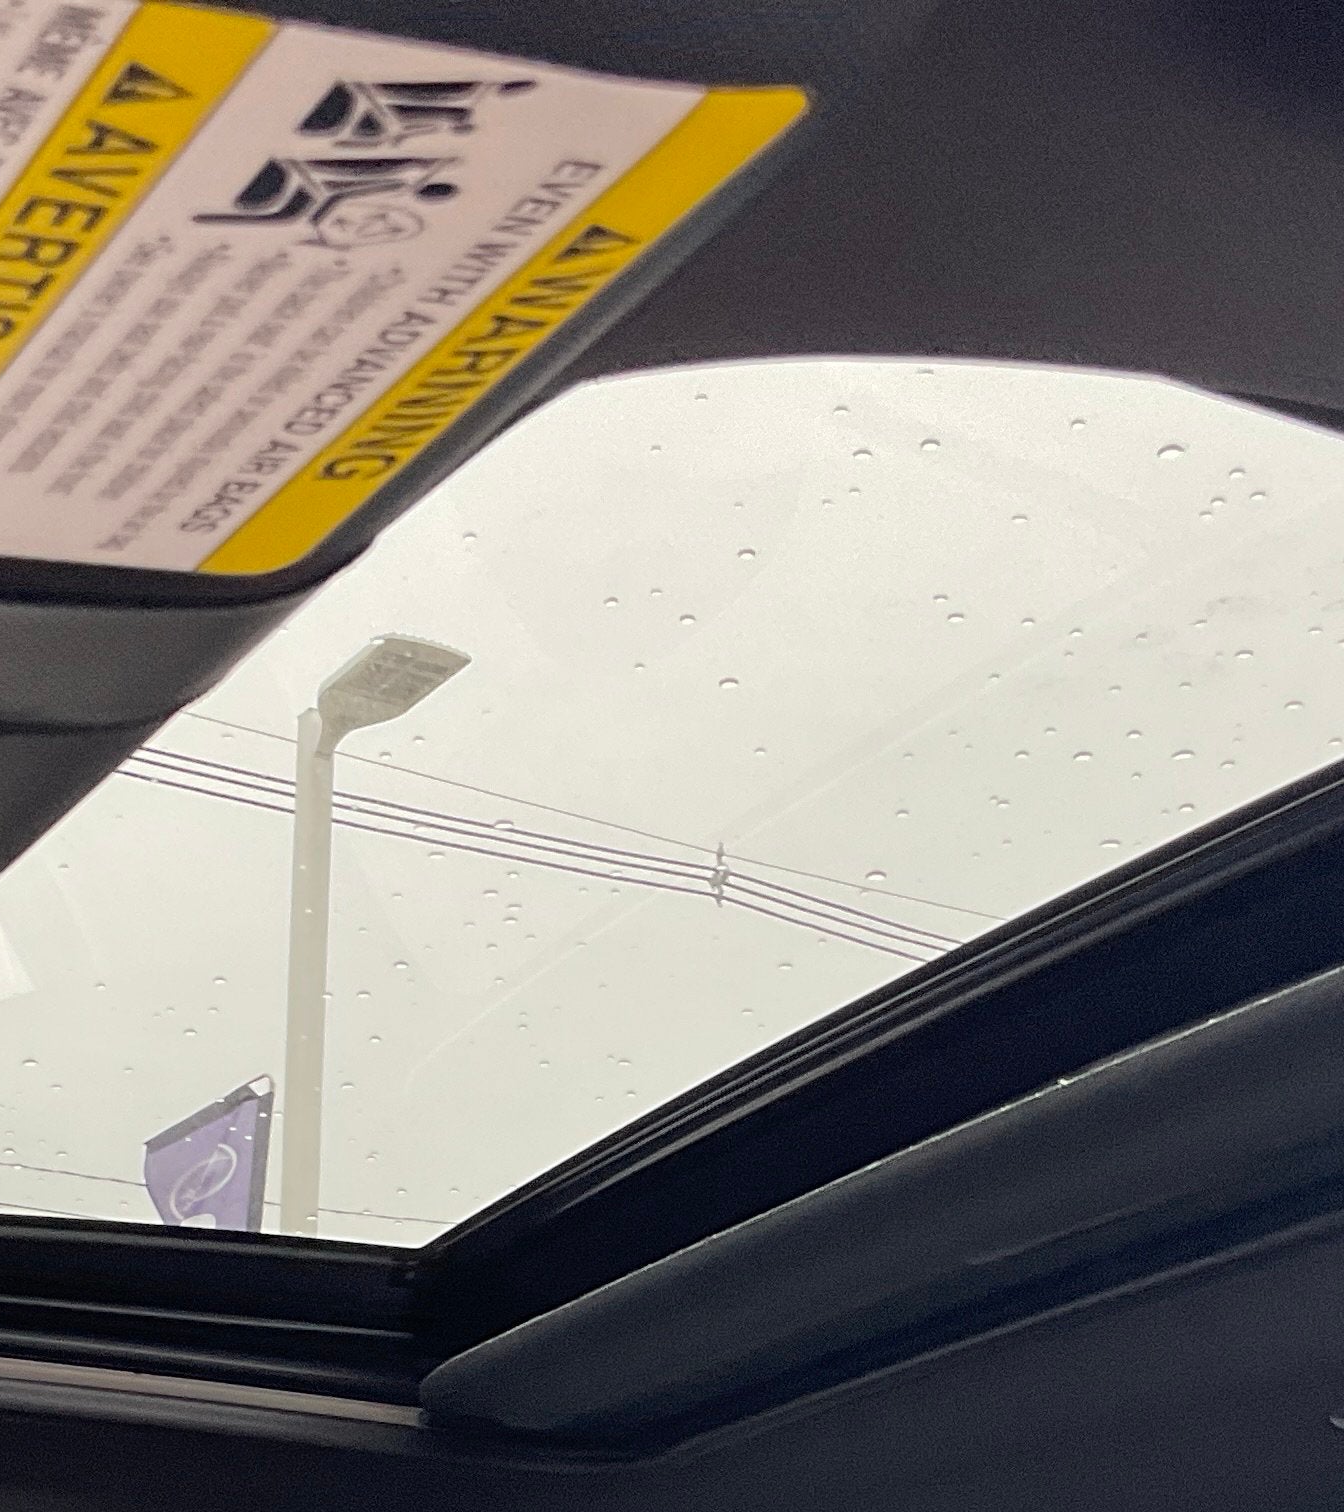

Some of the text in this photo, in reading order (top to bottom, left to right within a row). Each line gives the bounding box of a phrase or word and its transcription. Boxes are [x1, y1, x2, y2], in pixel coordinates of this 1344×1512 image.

[177, 159, 604, 531] EVEN WITH ADVANCED AIR BAGS
[317, 272, 599, 481] WARNING
